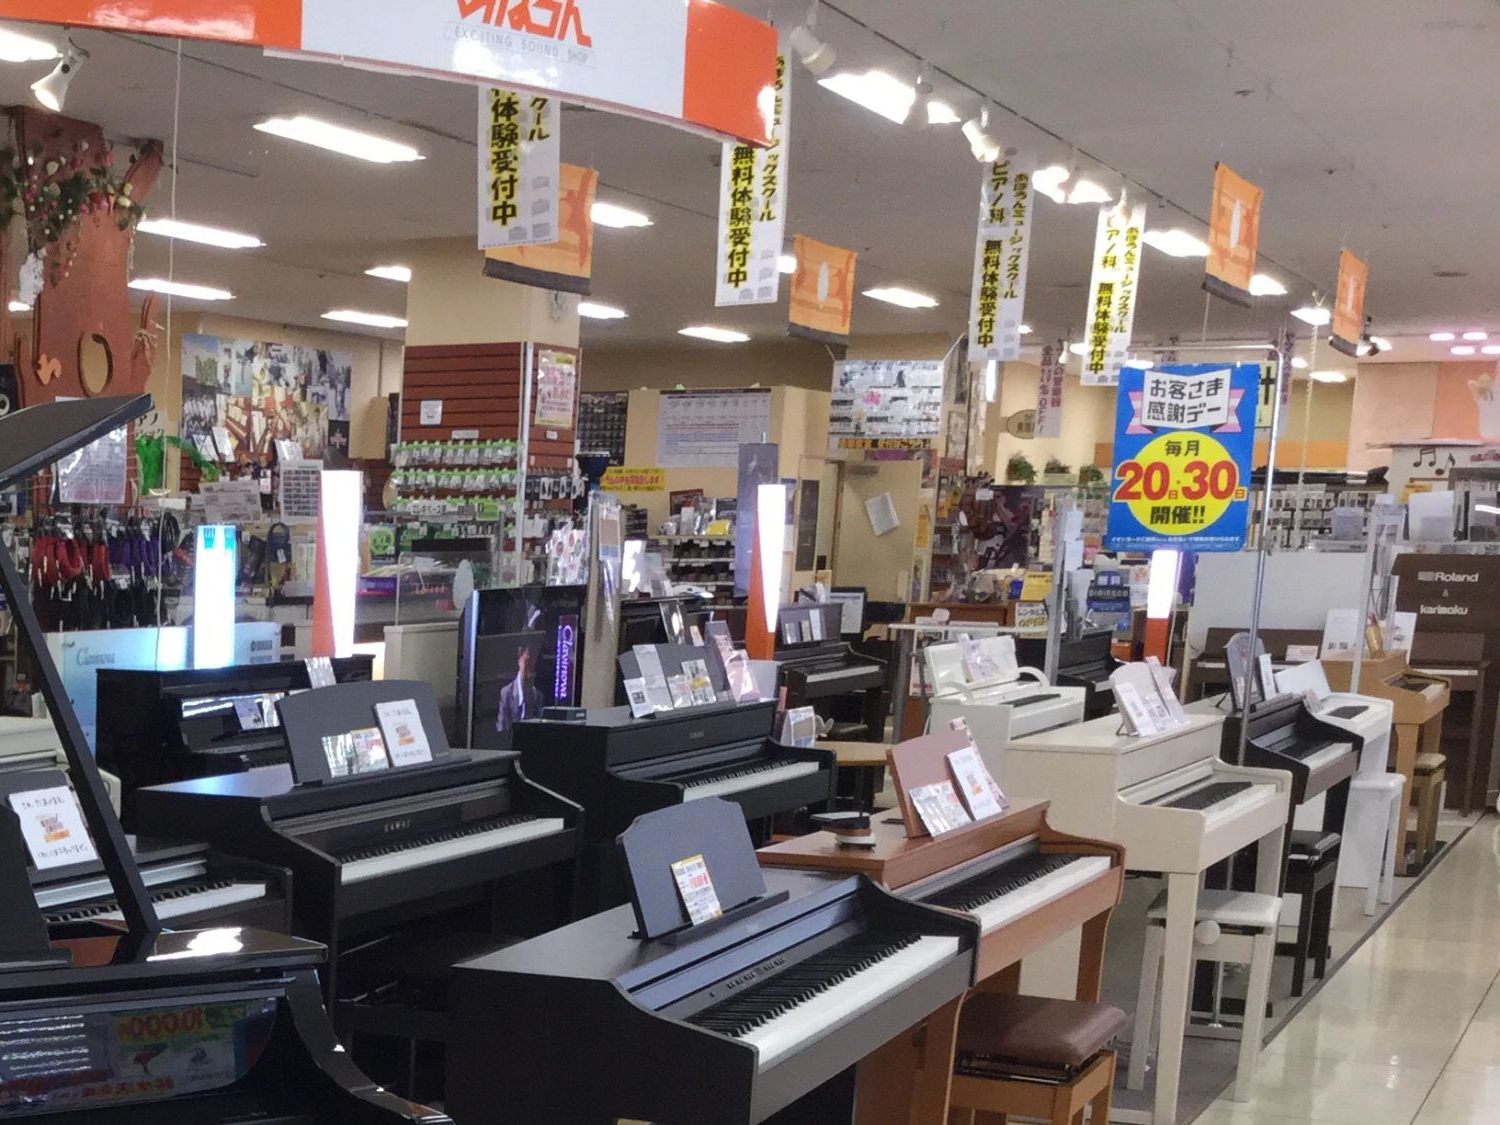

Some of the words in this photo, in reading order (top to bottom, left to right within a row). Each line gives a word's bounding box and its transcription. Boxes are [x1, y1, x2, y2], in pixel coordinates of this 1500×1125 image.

[522, 37, 559, 57] SOUND
[490, 88, 519, 226] 体験受付中
[727, 146, 756, 288] 無料体験受付中
[976, 238, 1003, 349] 無料体験受付中
[1088, 282, 1116, 375] 無料体験受付中
[1149, 377, 1225, 401] お客さま
[1146, 401, 1222, 424] 感謝デー
[1164, 440, 1200, 457] 毎月
[1150, 505, 1206, 525] 開催!!
[1434, 572, 1479, 583] Roland
[1420, 604, 1468, 616] karimoku
[560, 625, 575, 698] Clavinova
[384, 820, 411, 833] KAWAI
